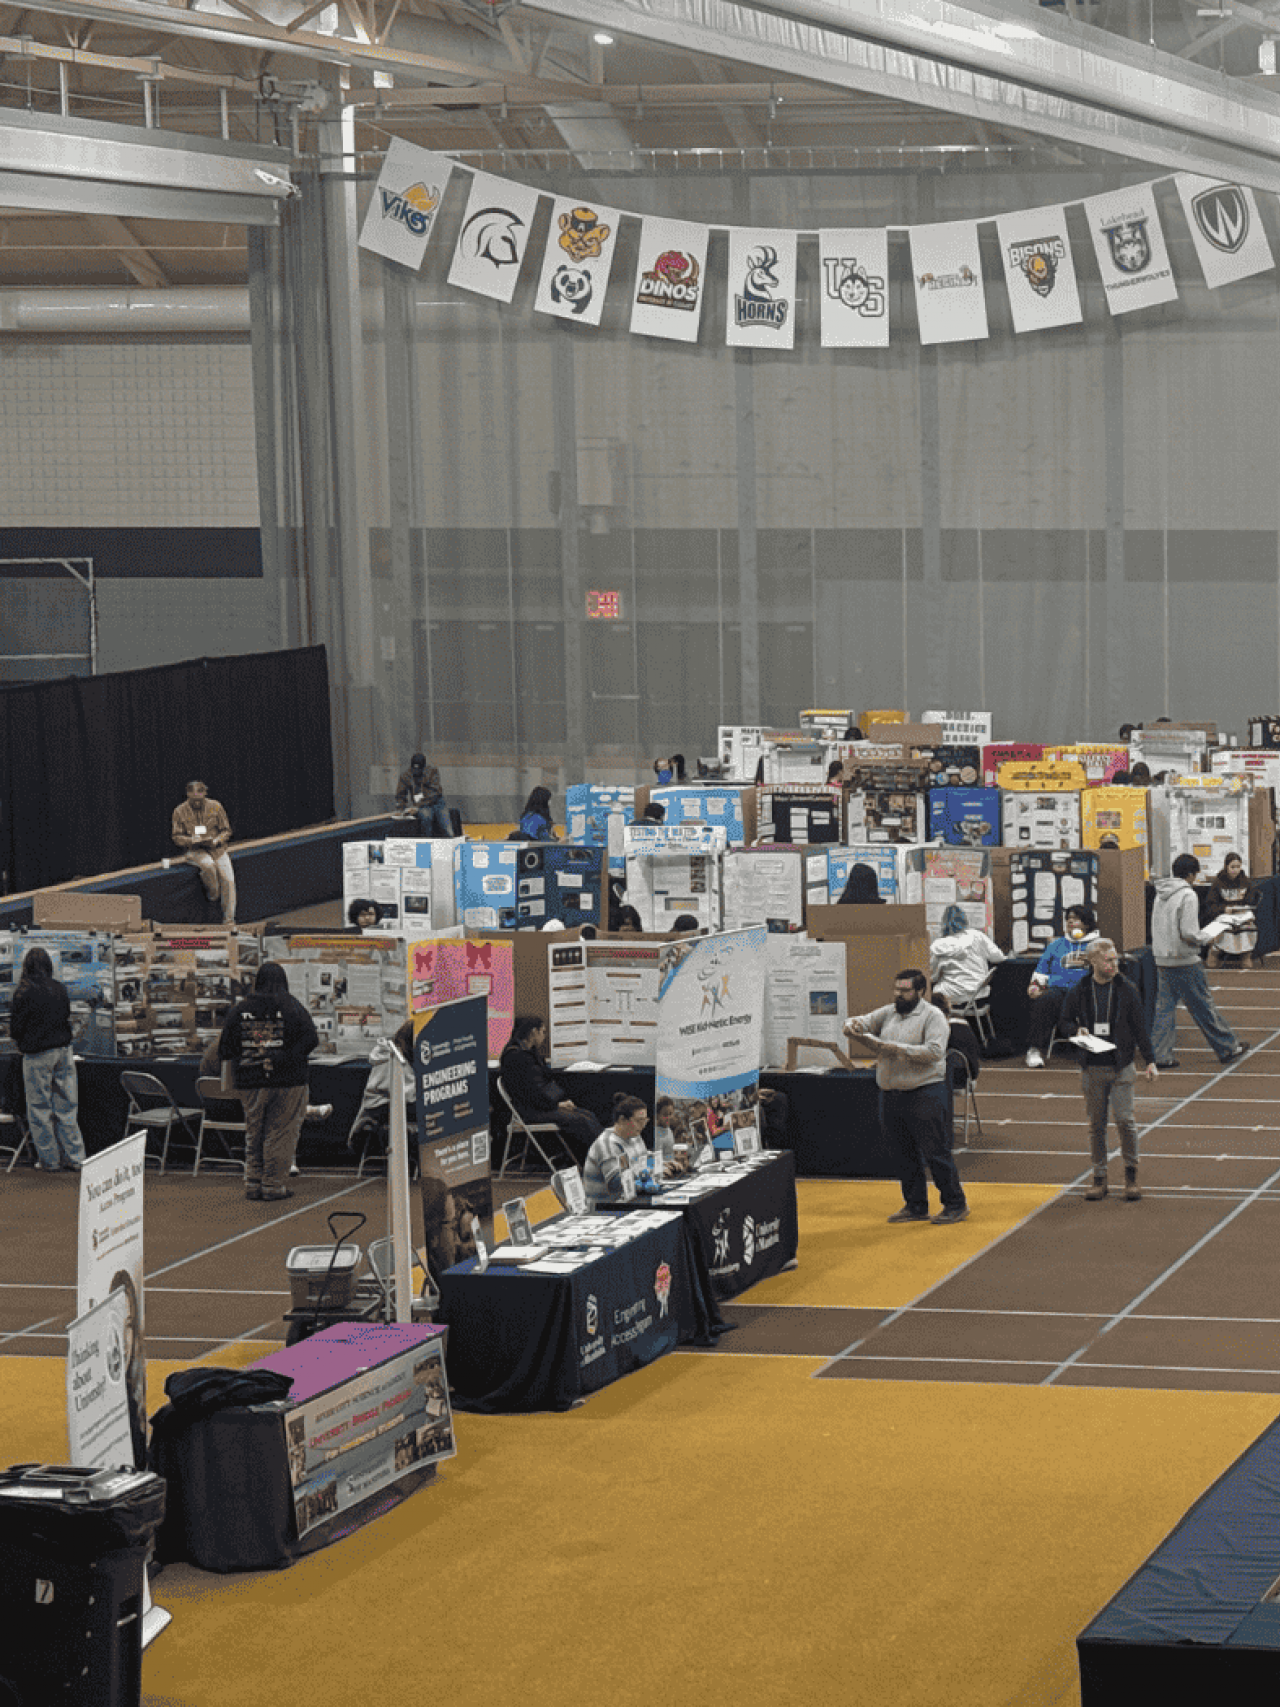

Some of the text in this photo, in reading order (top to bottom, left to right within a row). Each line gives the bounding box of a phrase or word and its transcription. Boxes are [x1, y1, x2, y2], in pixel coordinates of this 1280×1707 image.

[381, 189, 430, 235] Vikes
[1100, 206, 1145, 227] Lakehead
[1008, 238, 1066, 269] BISONS
[640, 278, 698, 302] DINOS
[737, 298, 787, 324] HORNS
[679, 1023, 698, 1036] WISE
[729, 1014, 752, 1027] Energy
[422, 1059, 477, 1091] ENGINEERING
[423, 1078, 469, 1107] PROGRAMS
[610, 1325, 639, 1348] Access
[71, 1339, 100, 1369] Thinking
[72, 1366, 92, 1391] about
